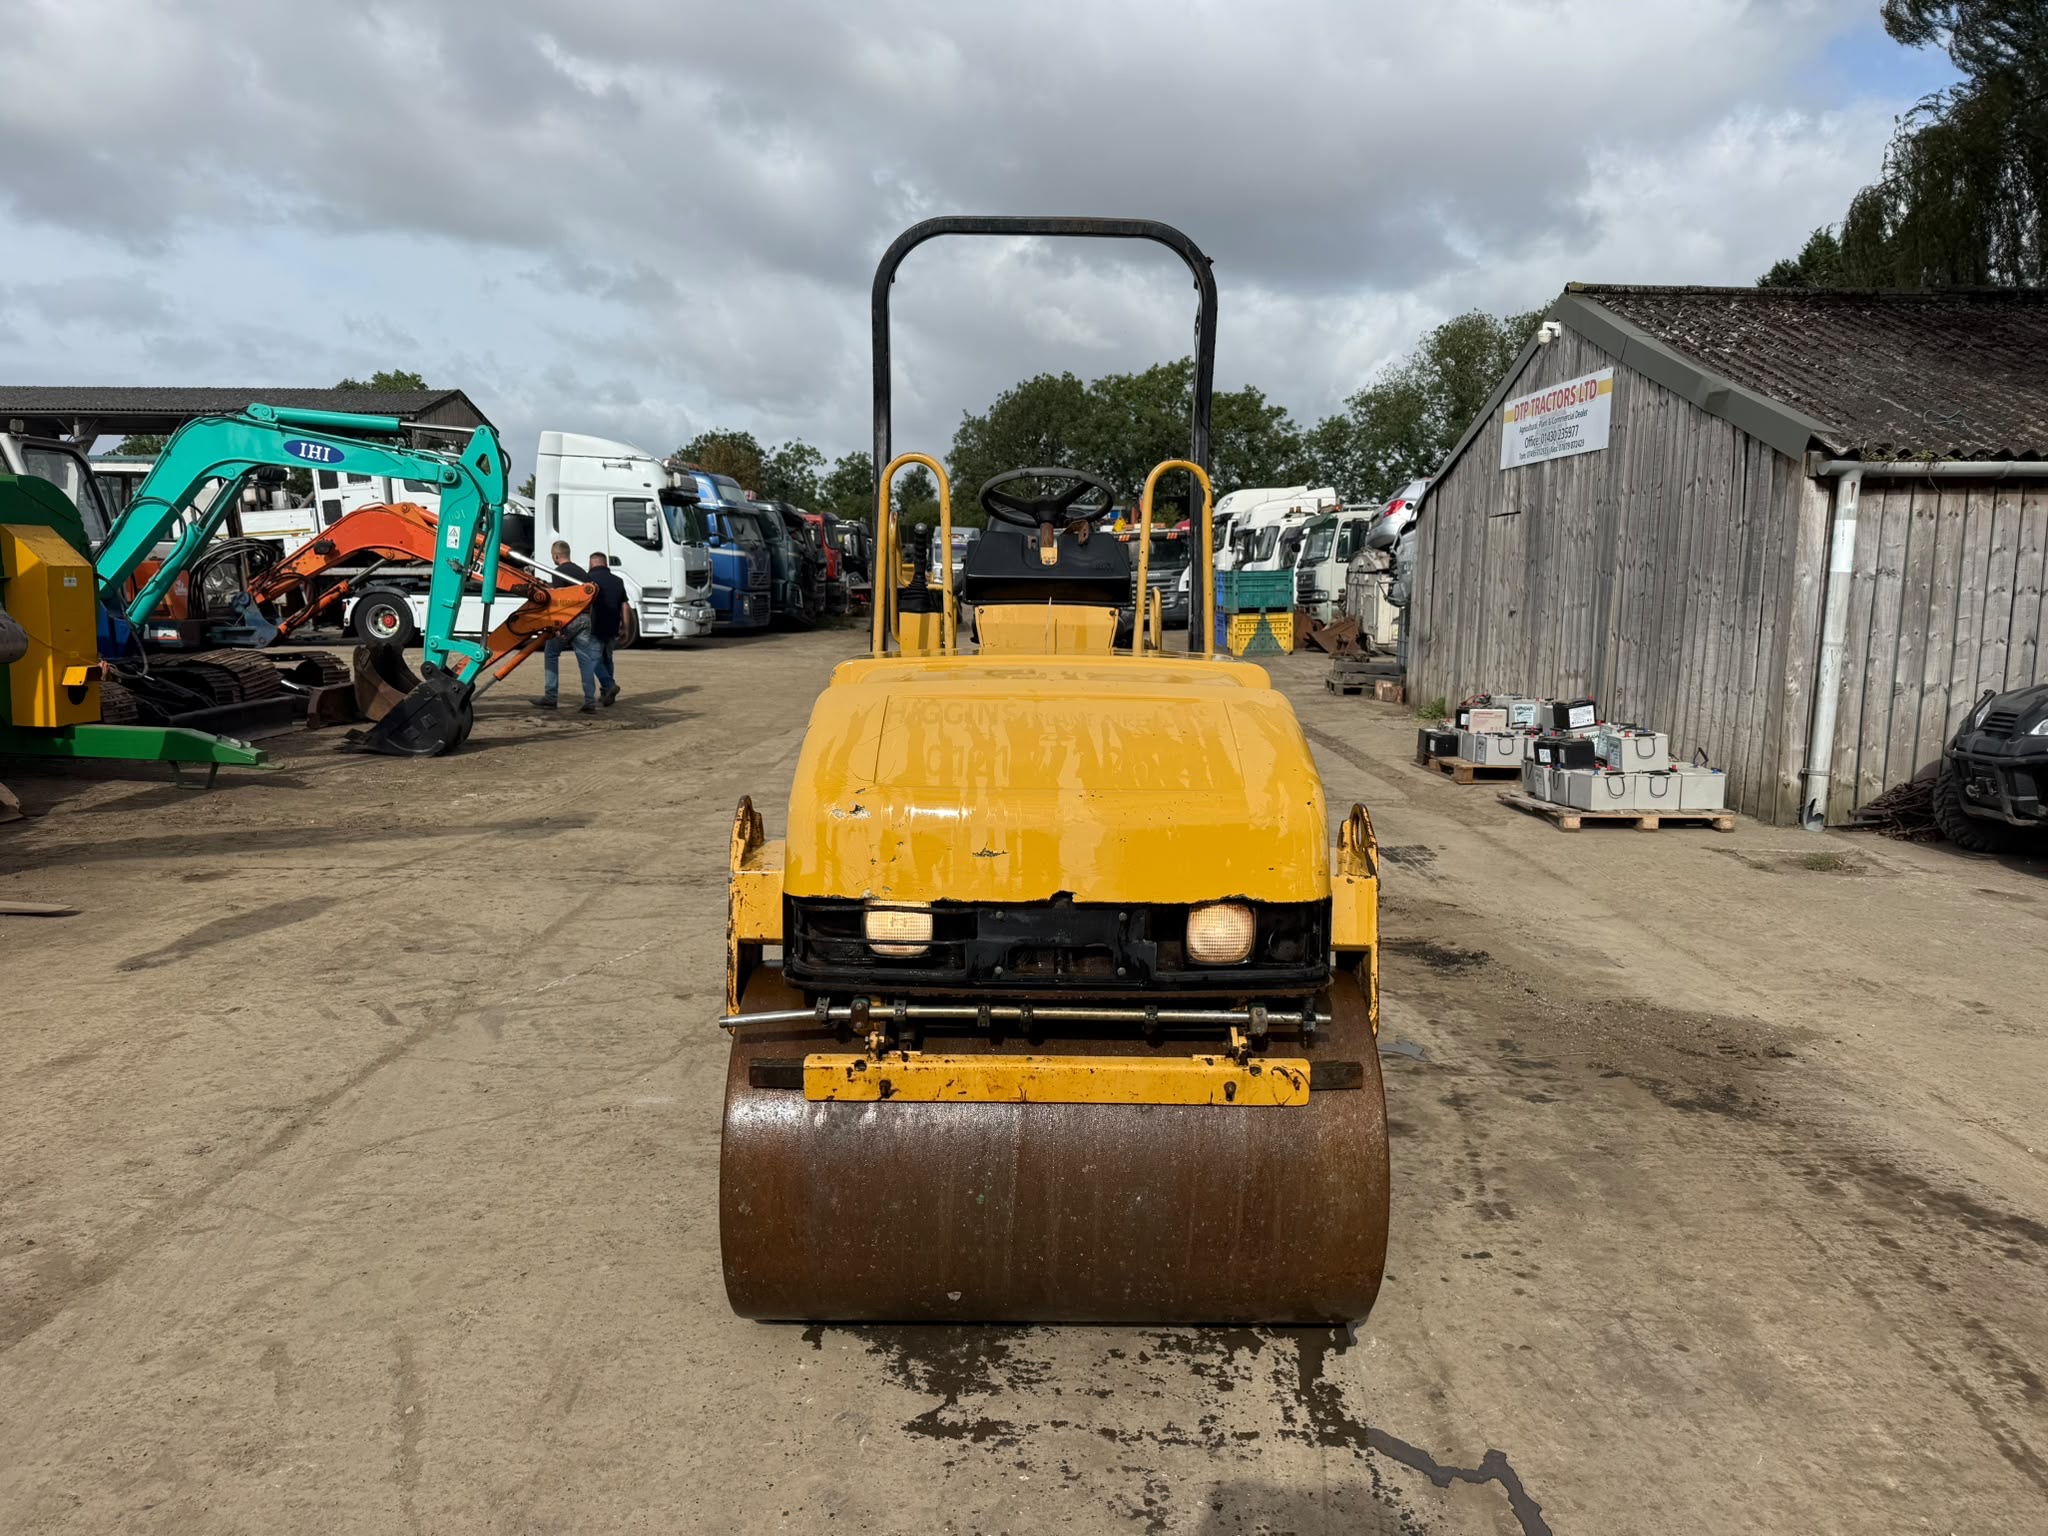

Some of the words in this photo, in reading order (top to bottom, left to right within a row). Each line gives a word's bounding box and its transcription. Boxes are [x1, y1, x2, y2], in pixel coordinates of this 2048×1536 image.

[1514, 402, 1529, 422] DTP
[1531, 385, 1576, 416] TRACTORS
[1579, 379, 1597, 403] LTD
[1551, 413, 1575, 425] Commercial
[1575, 408, 1589, 419] Dealer
[1541, 430, 1557, 444] 01430
[1558, 425, 1579, 440] 235977
[299, 442, 331, 462] IHI
